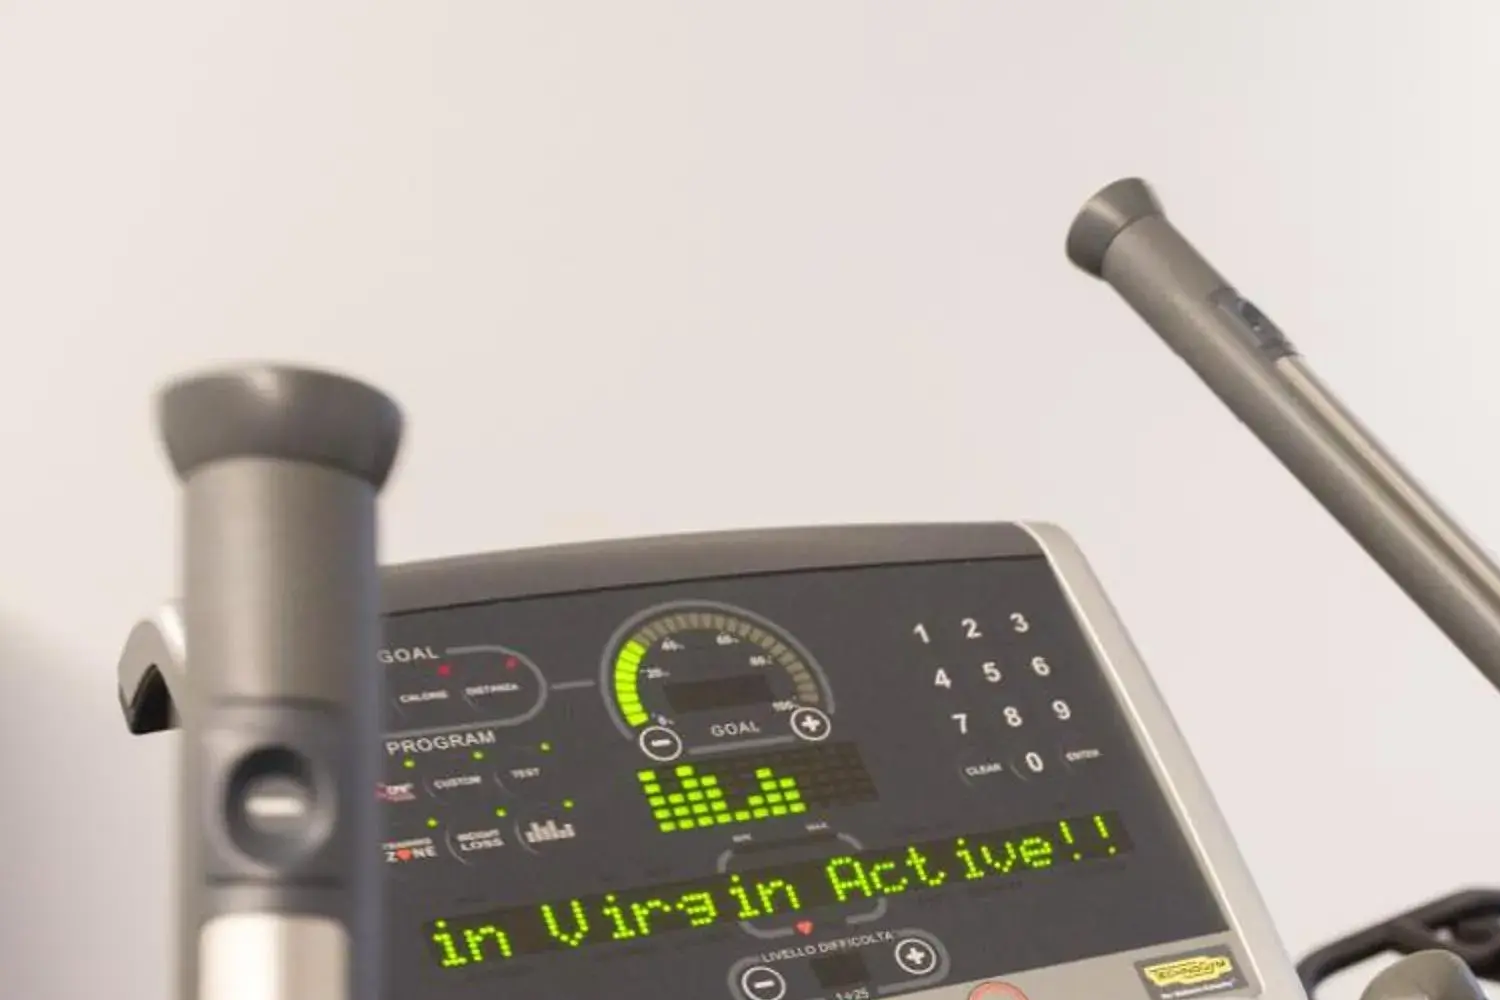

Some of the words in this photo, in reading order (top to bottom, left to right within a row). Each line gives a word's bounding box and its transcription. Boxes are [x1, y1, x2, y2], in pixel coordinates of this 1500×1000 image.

[914, 623, 930, 644] 1
[962, 618, 982, 639] 2
[1009, 612, 1030, 633] 3
[376, 647, 440, 664] GOAL
[934, 668, 951, 688] 4
[983, 662, 1001, 683] 5
[1031, 656, 1051, 677] 6
[951, 713, 969, 734] 7
[1003, 706, 1023, 728] 8
[1052, 700, 1071, 721] 9
[710, 720, 761, 738] GOAL
[385, 730, 496, 755] PROGRAM
[964, 762, 1003, 777] CLEAR
[1025, 752, 1044, 773] 0
[509, 767, 541, 780] TEST
[460, 836, 505, 851] LOSS
[432, 919, 512, 967] in
[541, 874, 801, 947] Virgin
[825, 815, 1118, 902] Active!!
[761, 945, 817, 964] LIVELLO
